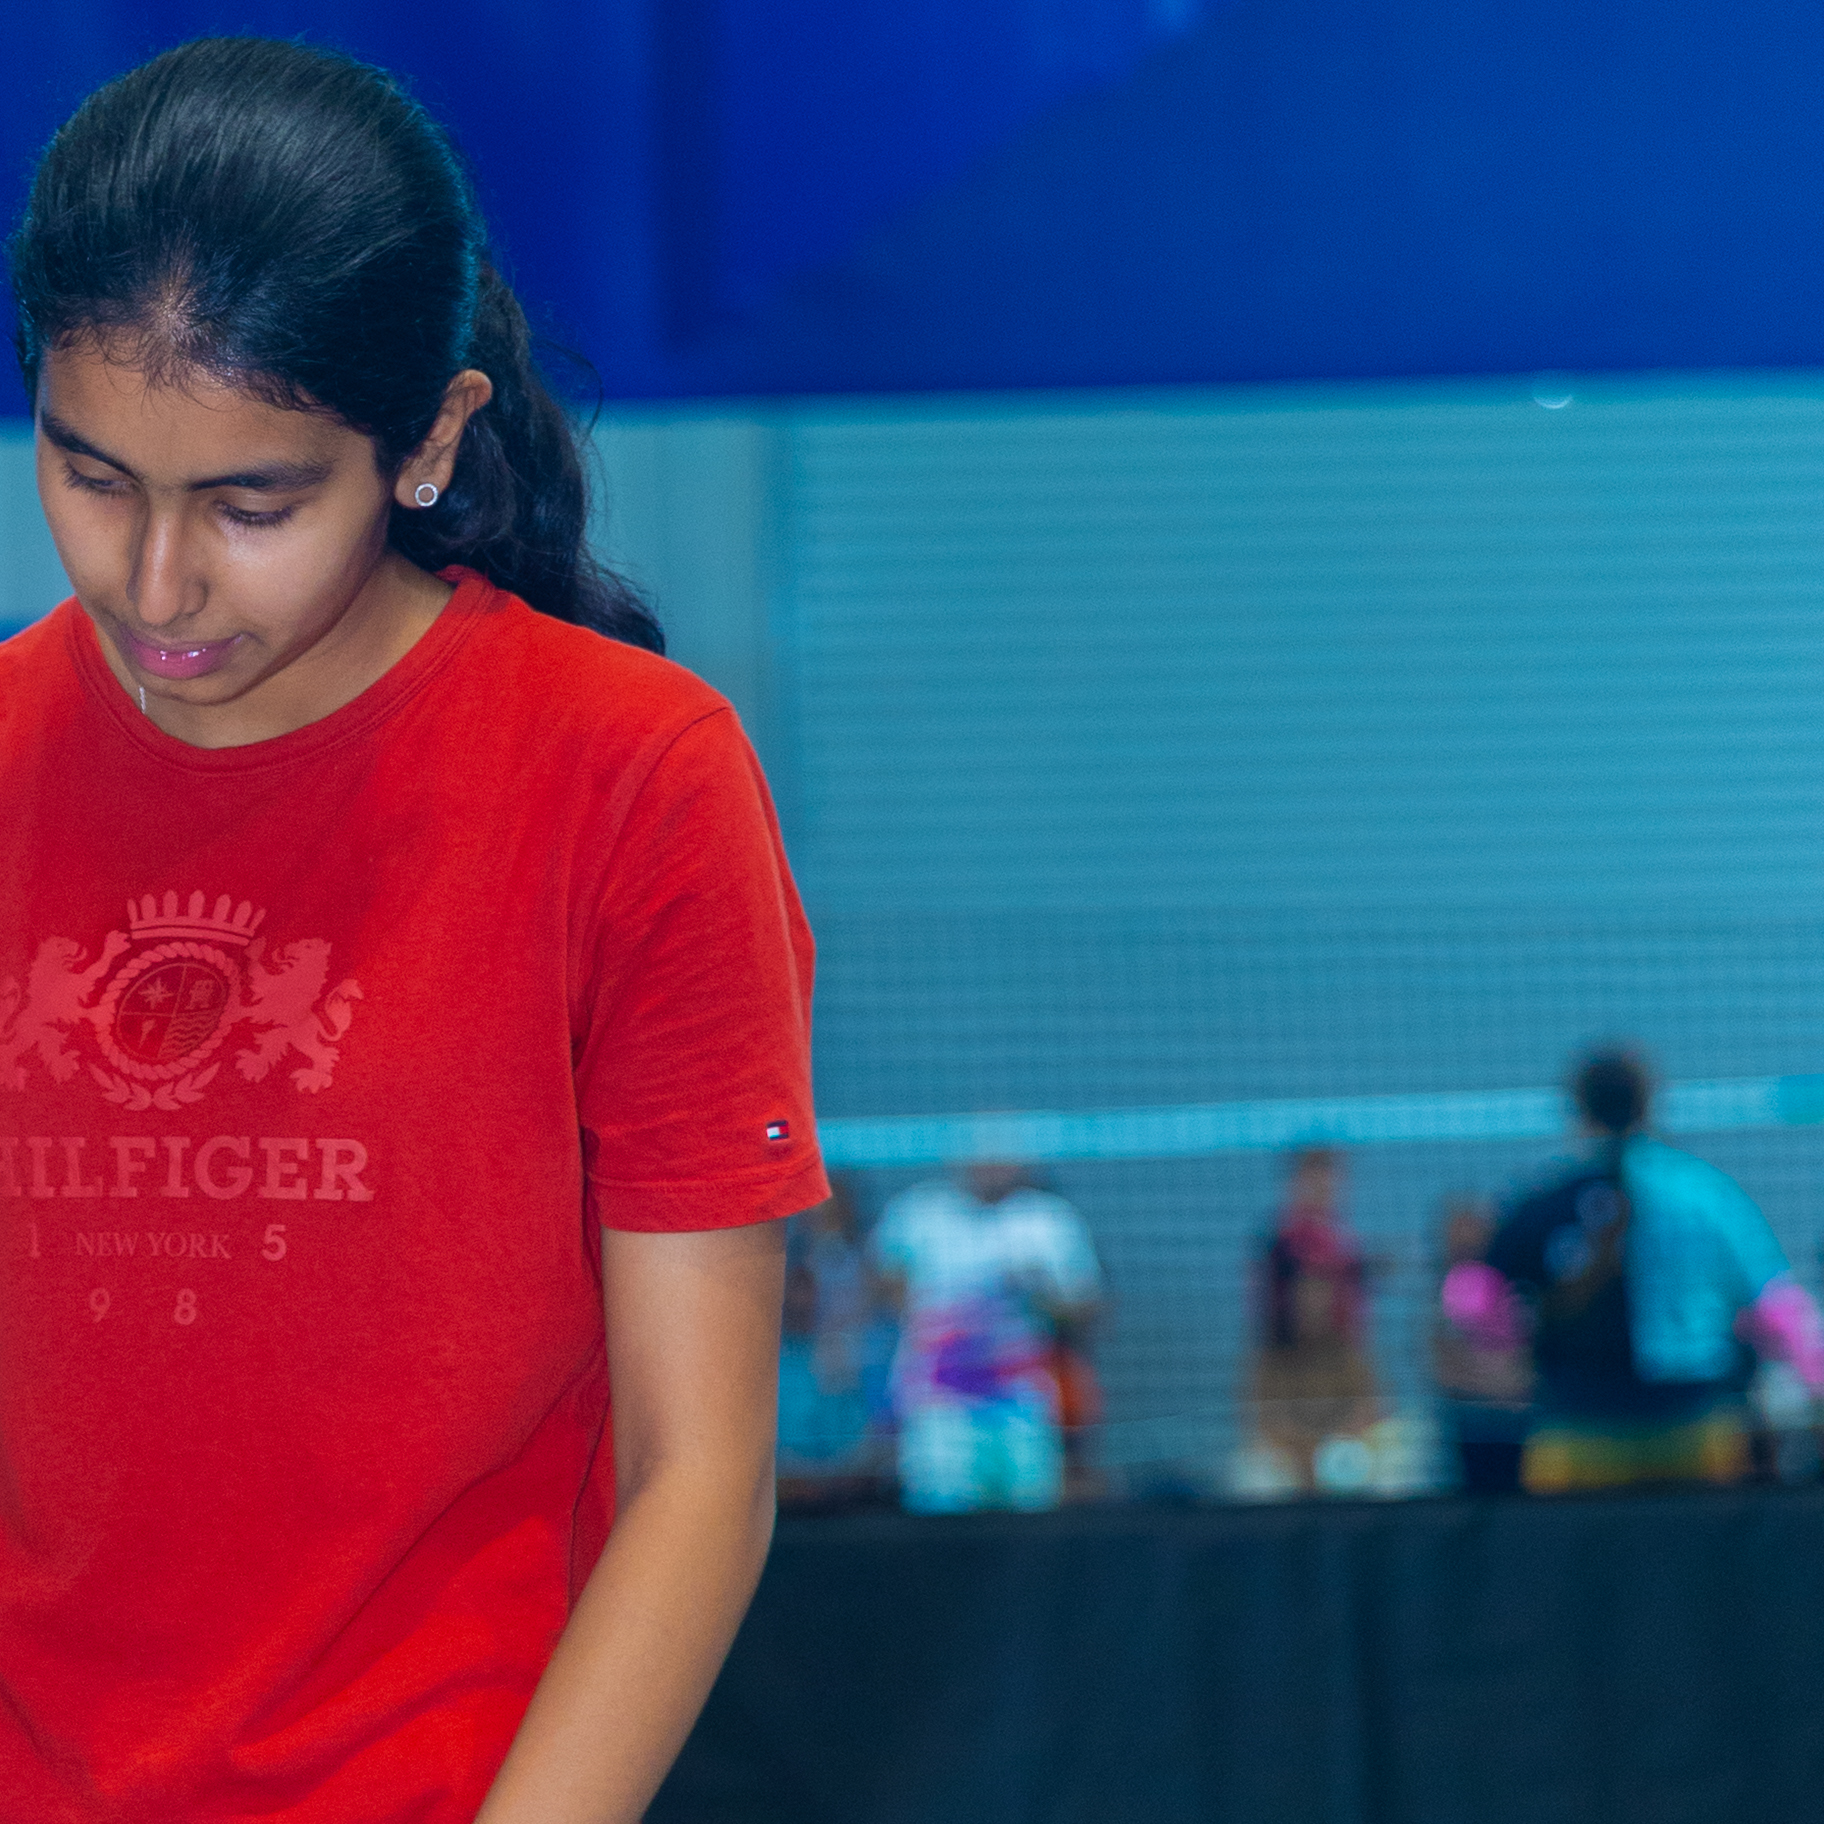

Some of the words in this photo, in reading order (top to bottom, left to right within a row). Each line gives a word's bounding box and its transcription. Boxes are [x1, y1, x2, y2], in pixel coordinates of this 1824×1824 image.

[76, 1232, 140, 1257] NEW
[146, 1231, 233, 1260] YORK
[261, 1224, 288, 1261] 5
[89, 1288, 112, 1323] 9
[173, 1288, 198, 1326] 8
